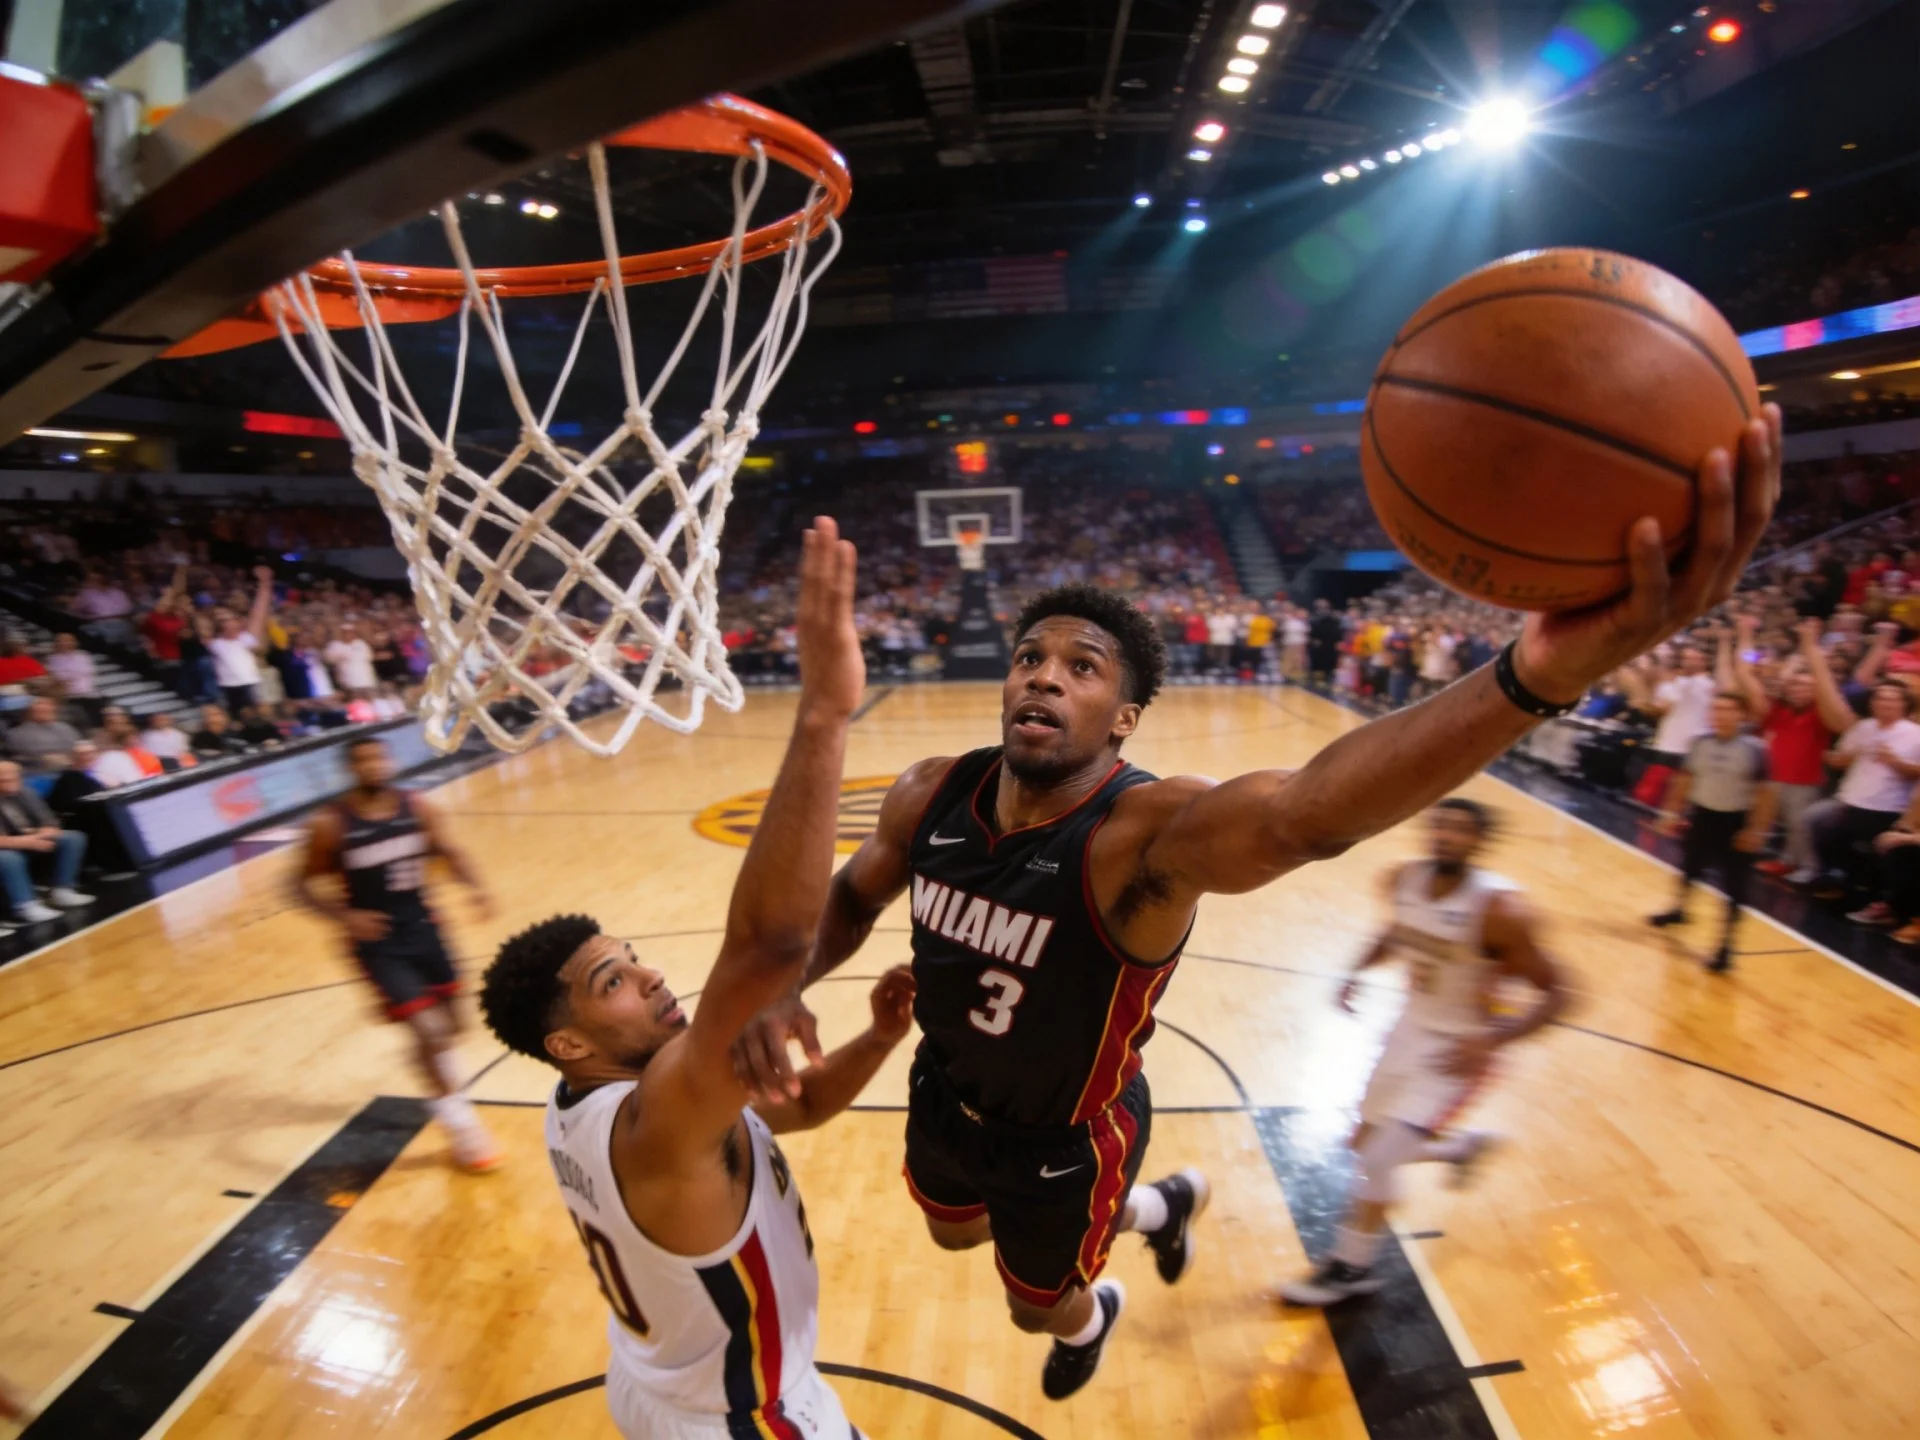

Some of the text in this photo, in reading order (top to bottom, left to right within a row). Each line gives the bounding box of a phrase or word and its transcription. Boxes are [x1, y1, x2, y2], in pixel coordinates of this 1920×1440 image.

[911, 871, 1055, 969] MILAMI
[968, 968, 1024, 1037] 3
[569, 1206, 651, 1338] 0
